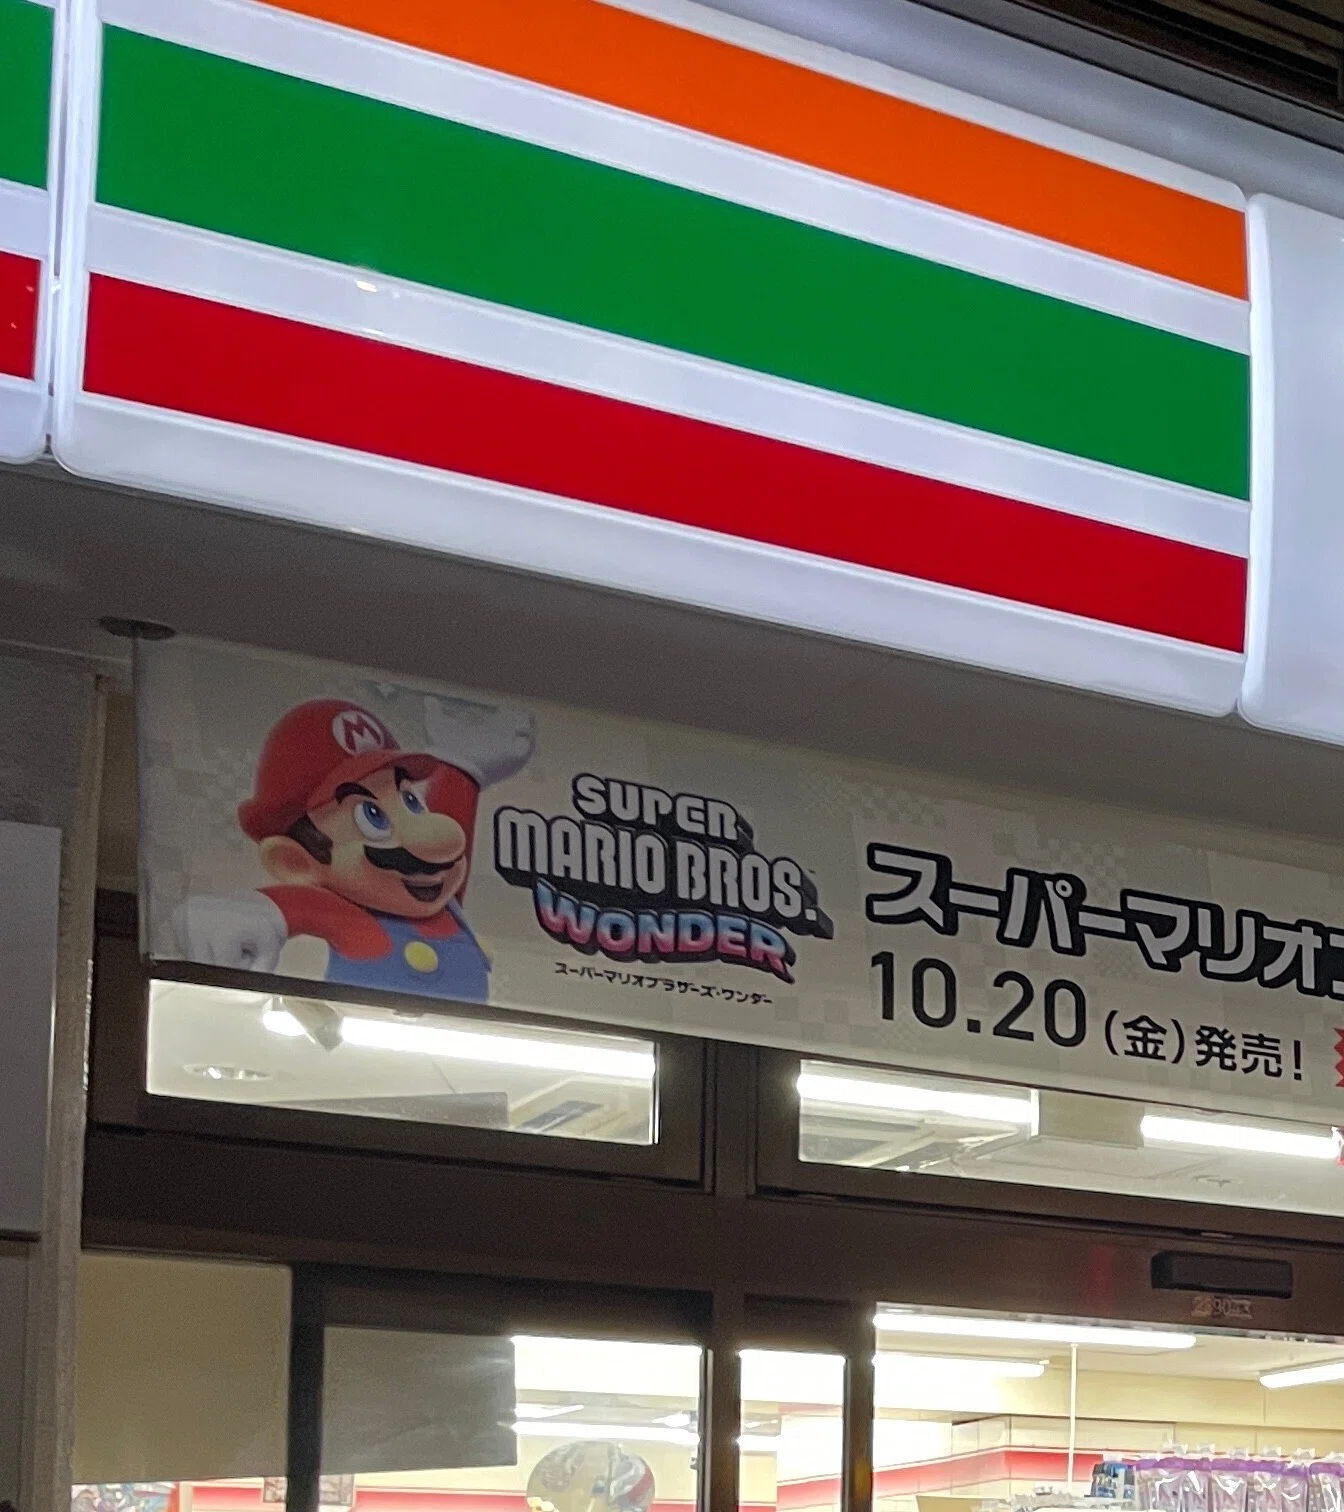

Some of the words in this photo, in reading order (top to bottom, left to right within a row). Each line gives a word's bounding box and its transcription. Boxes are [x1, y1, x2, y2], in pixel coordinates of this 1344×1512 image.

[574, 775, 743, 839] SUPER
[496, 808, 672, 897] MARIO
[535, 880, 795, 982] WONDER
